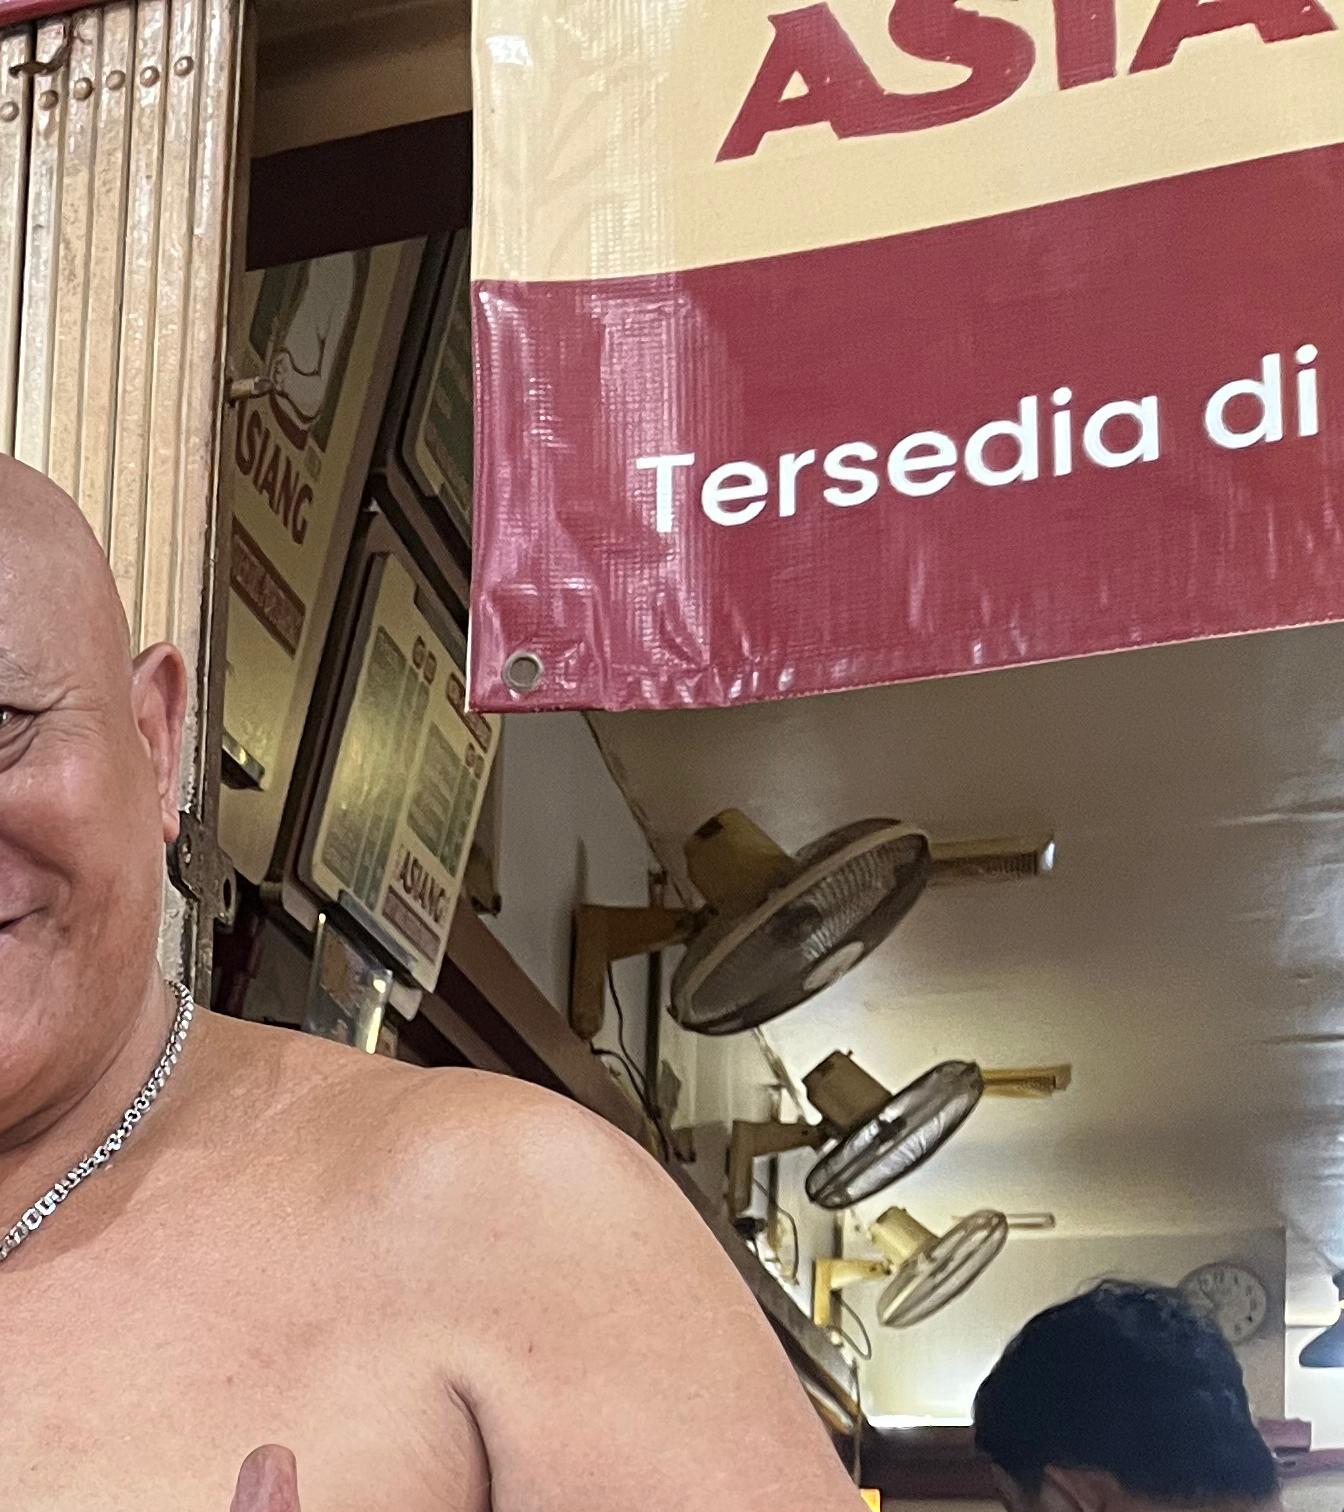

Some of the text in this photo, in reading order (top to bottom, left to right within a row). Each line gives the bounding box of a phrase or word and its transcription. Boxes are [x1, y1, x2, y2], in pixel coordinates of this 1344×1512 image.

[234, 398, 314, 545] SIANG
[636, 343, 1320, 535] Tersedia di
